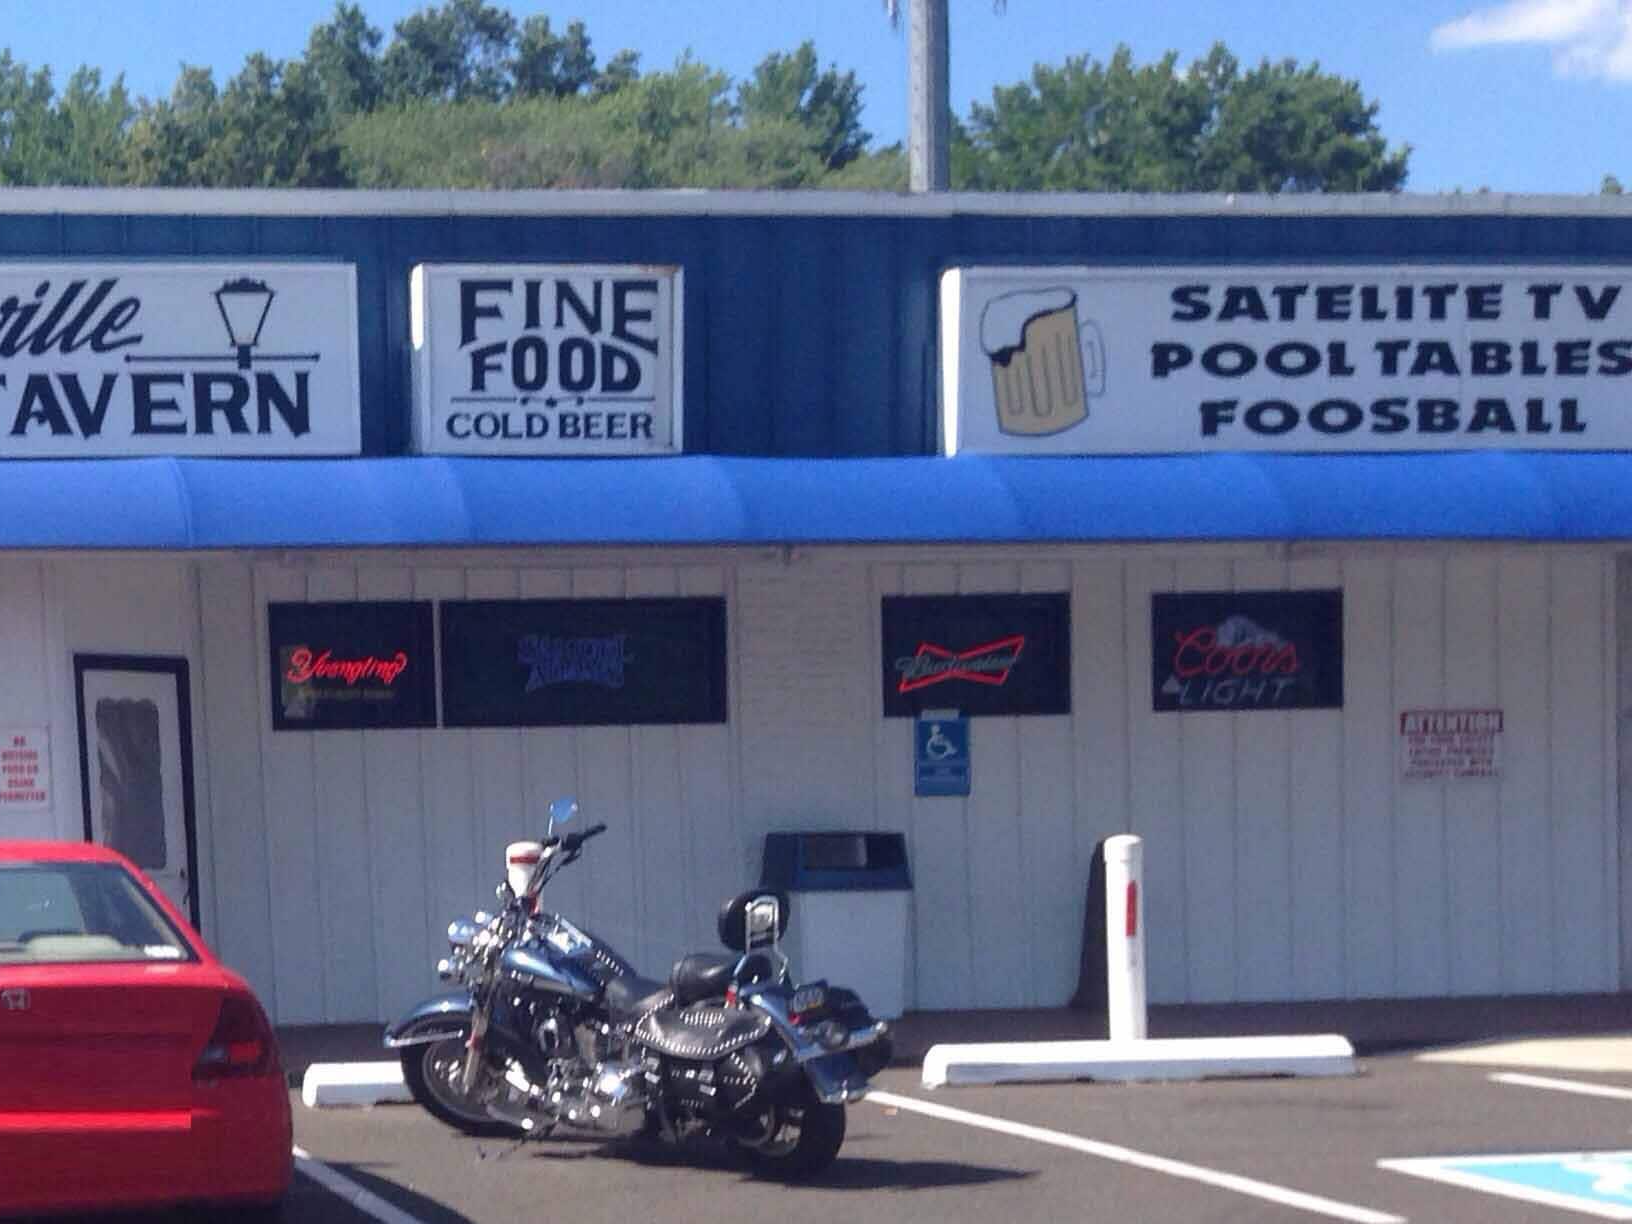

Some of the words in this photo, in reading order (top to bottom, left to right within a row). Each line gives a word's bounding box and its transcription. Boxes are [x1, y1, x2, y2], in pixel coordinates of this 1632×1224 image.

[458, 279, 659, 357] FINE
[1169, 283, 1504, 323] SATELITE
[1525, 283, 1623, 321] TV
[470, 335, 641, 393] FOOD
[1149, 340, 1356, 380] POOL
[1374, 338, 1632, 378] TABLES
[446, 412, 550, 440] COLD
[558, 412, 655, 440] BEER
[1199, 396, 1588, 438] FOOSBALL
[1174, 624, 1300, 679] Coors
[1179, 677, 1297, 705] LIGHT
